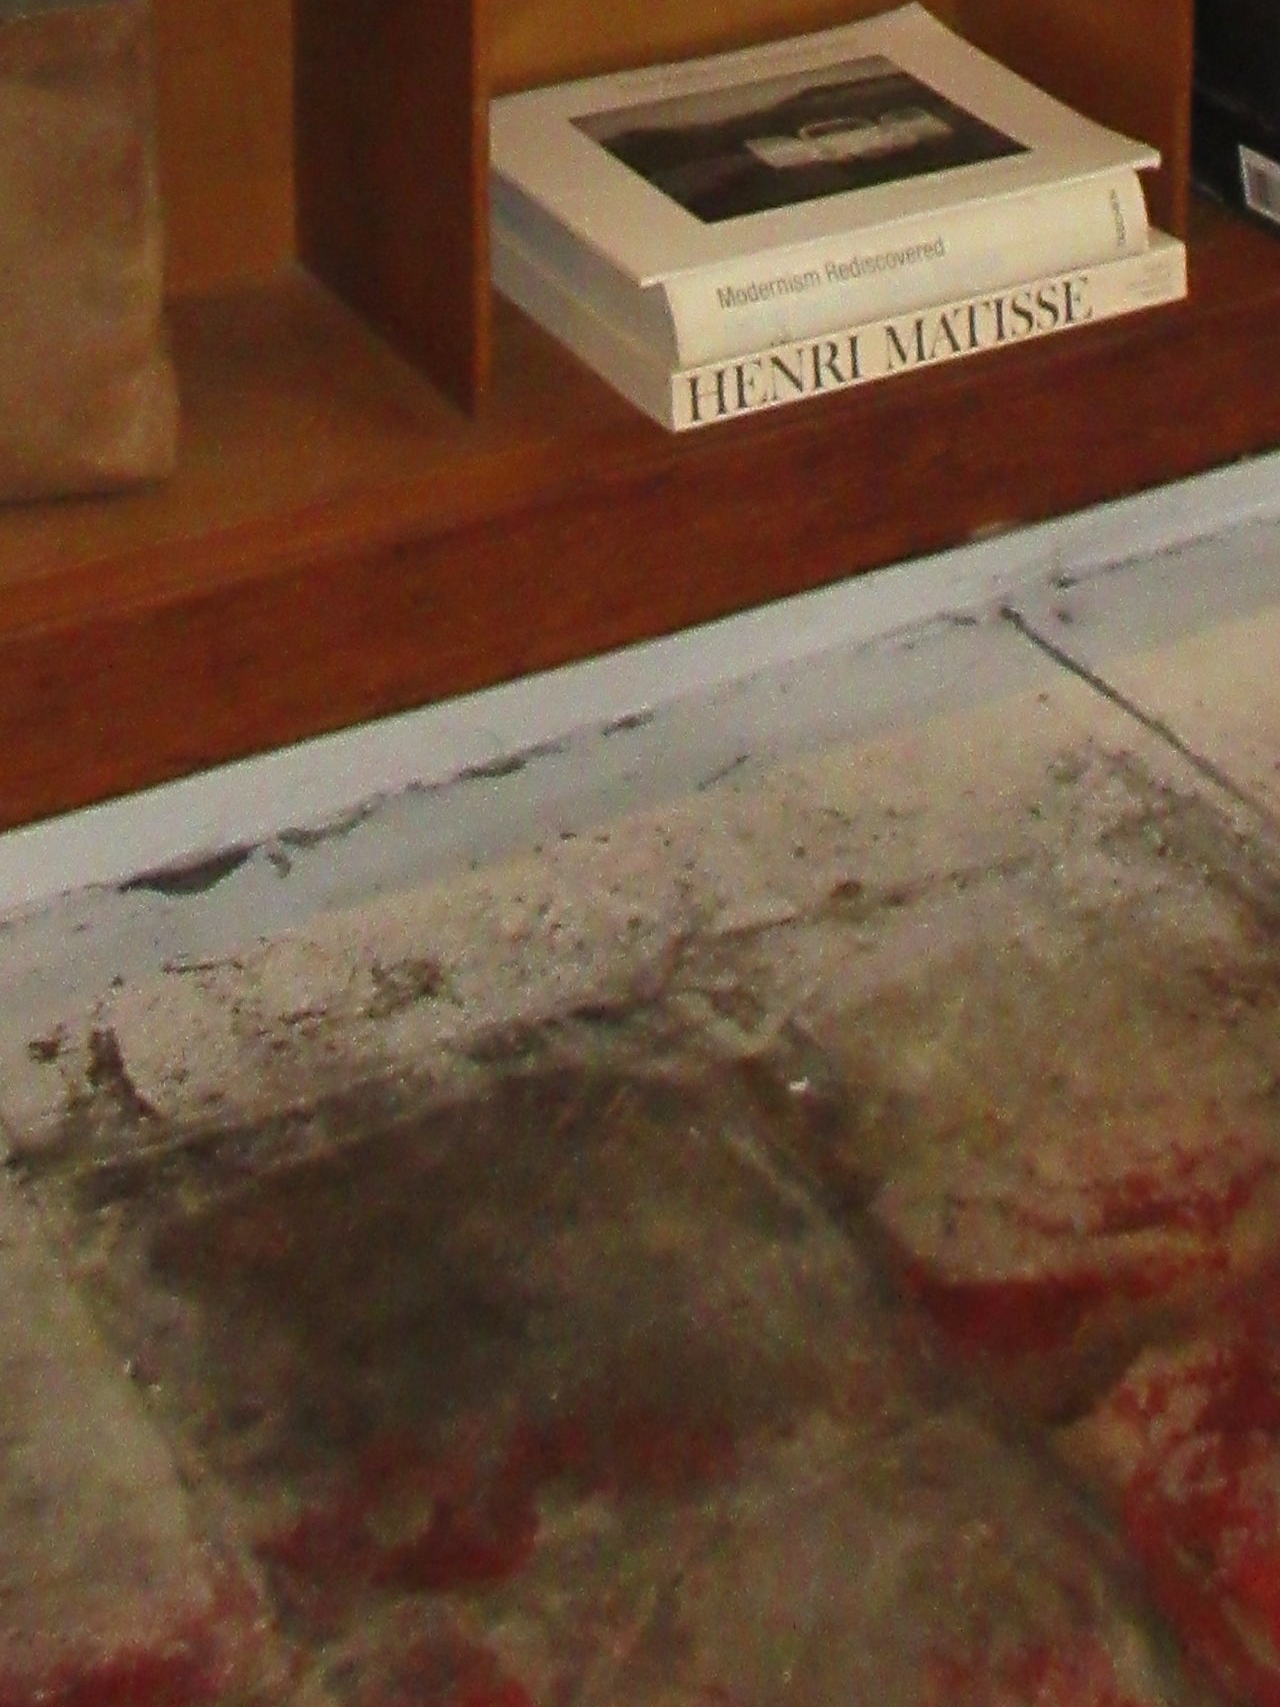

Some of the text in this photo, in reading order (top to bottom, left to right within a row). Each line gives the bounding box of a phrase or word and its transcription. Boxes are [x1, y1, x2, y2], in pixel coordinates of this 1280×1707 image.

[716, 235, 947, 309] Modernism Rediscovered
[687, 276, 1093, 423] HENRI MATISSE
